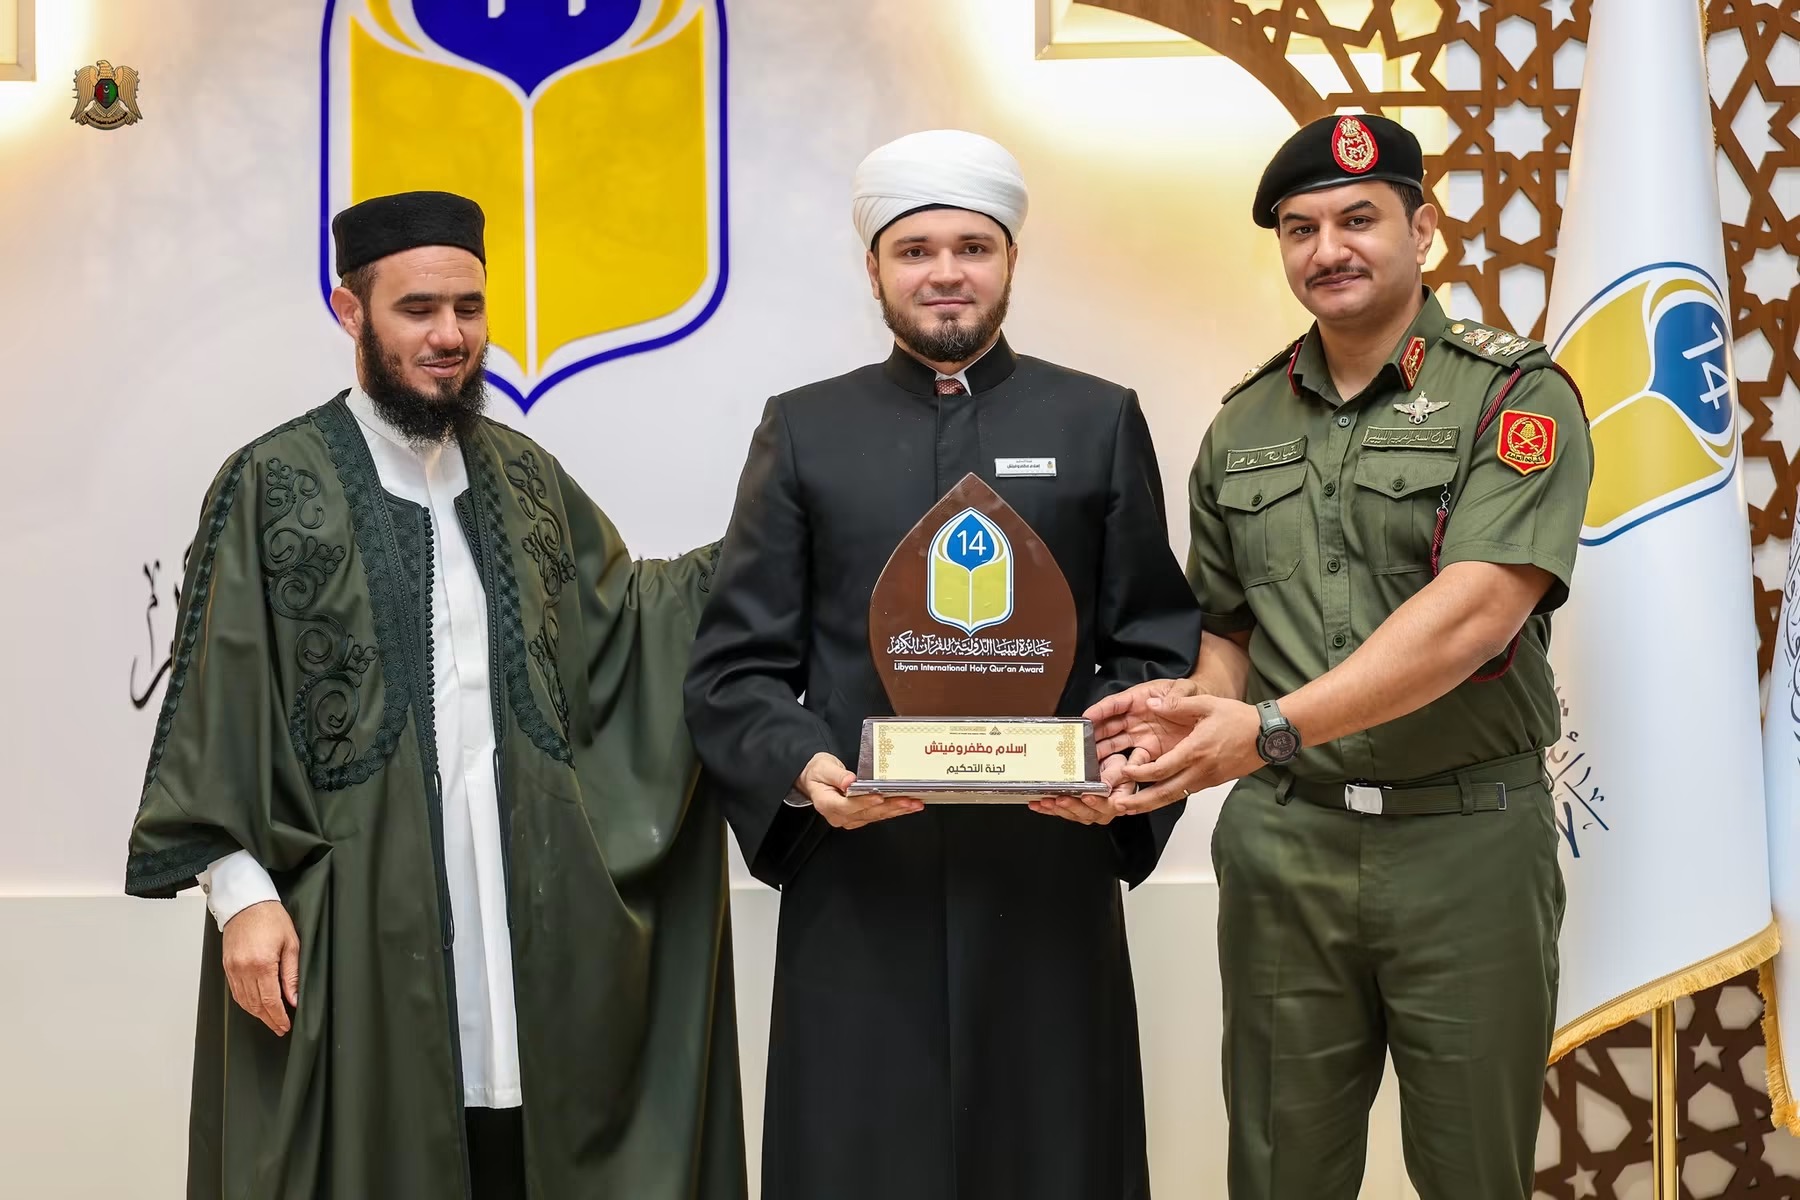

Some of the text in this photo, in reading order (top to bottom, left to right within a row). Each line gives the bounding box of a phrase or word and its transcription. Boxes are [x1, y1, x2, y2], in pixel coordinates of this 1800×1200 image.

[1682, 321, 1730, 410] 14
[956, 530, 987, 556] 14
[894, 663, 919, 673] Libyan
[920, 663, 968, 673] International
[969, 664, 988, 674] Holy
[1018, 665, 1045, 674] Award
[924, 740, 1027, 757] إسلام مظفروفيتش
[946, 763, 1006, 775] لجنة التحكيم
